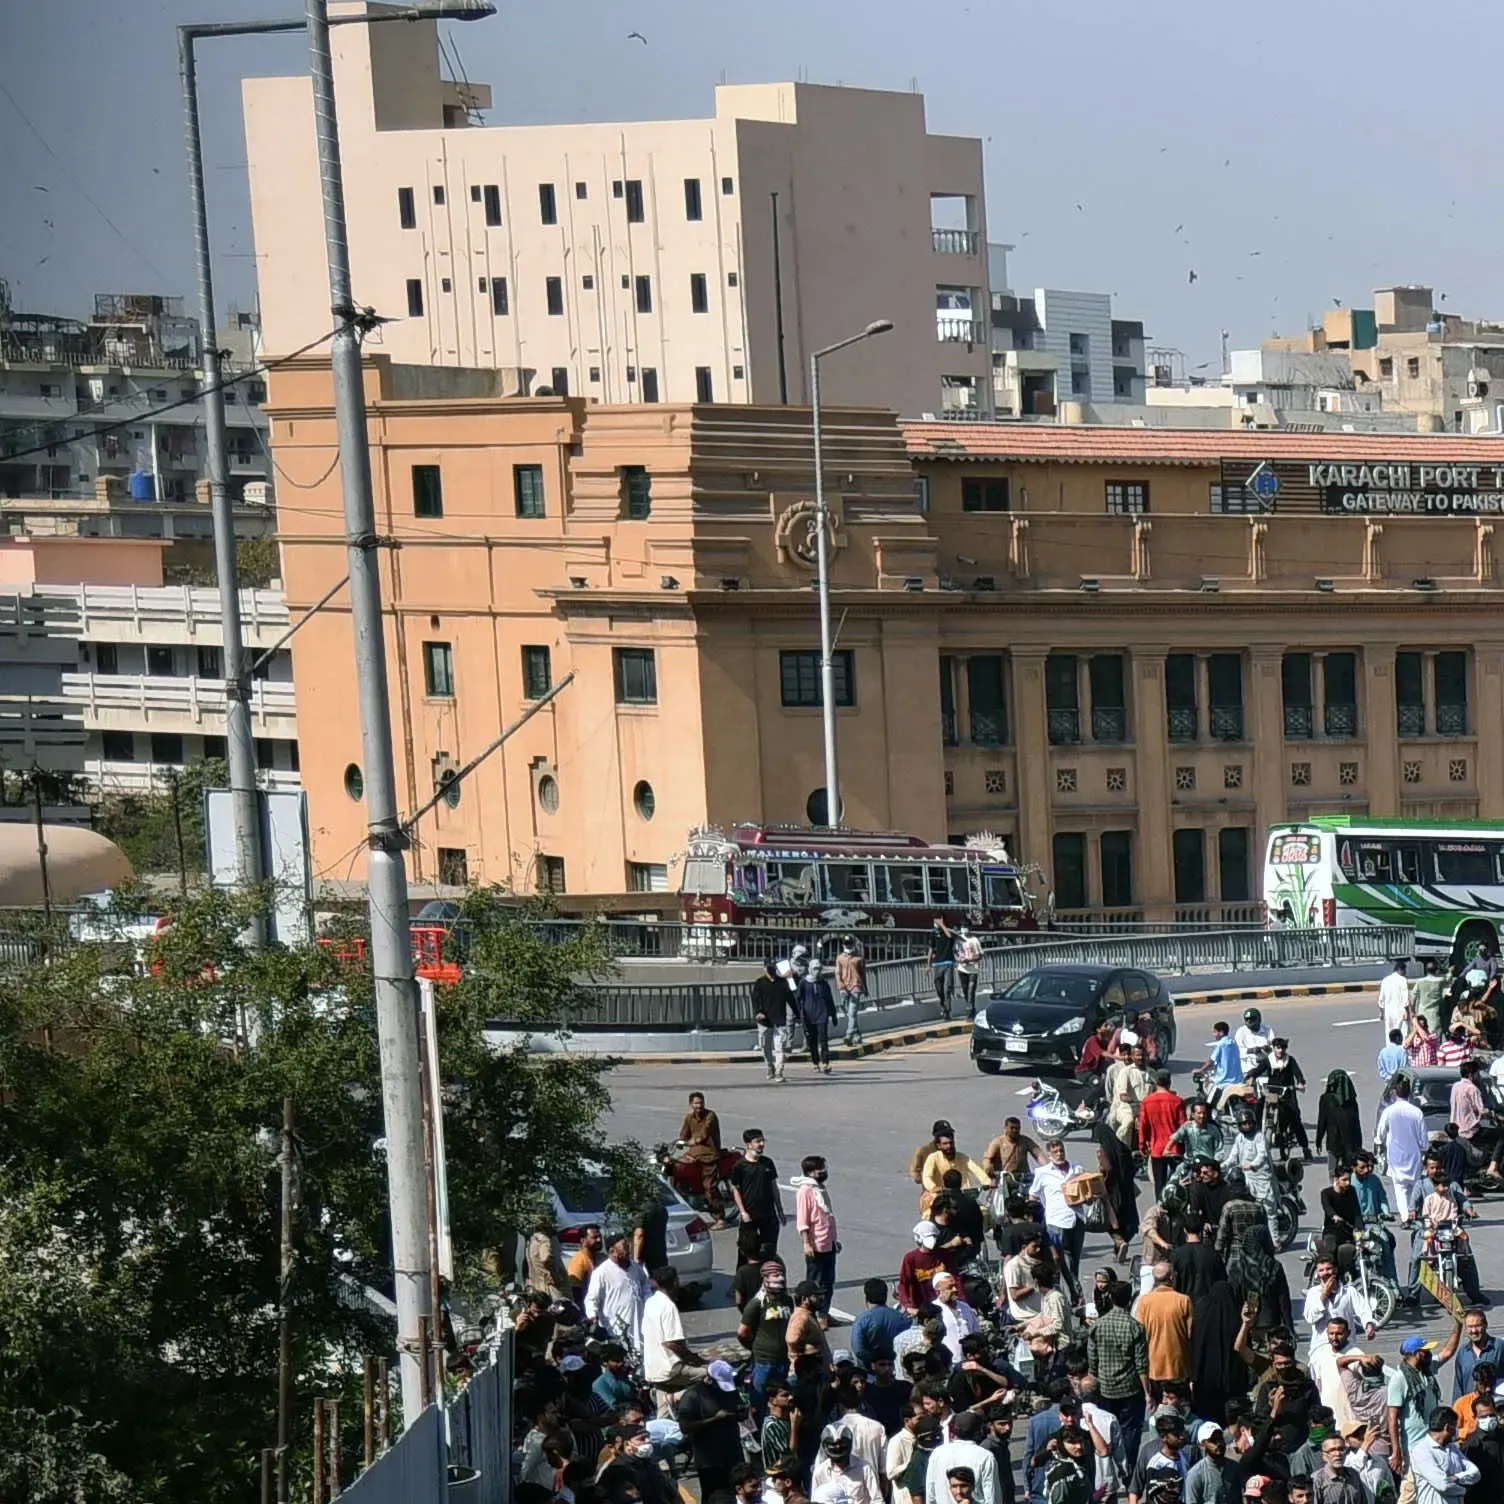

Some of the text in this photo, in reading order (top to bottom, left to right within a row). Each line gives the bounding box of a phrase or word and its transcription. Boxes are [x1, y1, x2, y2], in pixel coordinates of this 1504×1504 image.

[1309, 464, 1412, 488] KARACHI
[1420, 466, 1481, 488] PORT
[1342, 492, 1420, 510] GATEWAY
[1424, 493, 1448, 510] TO
